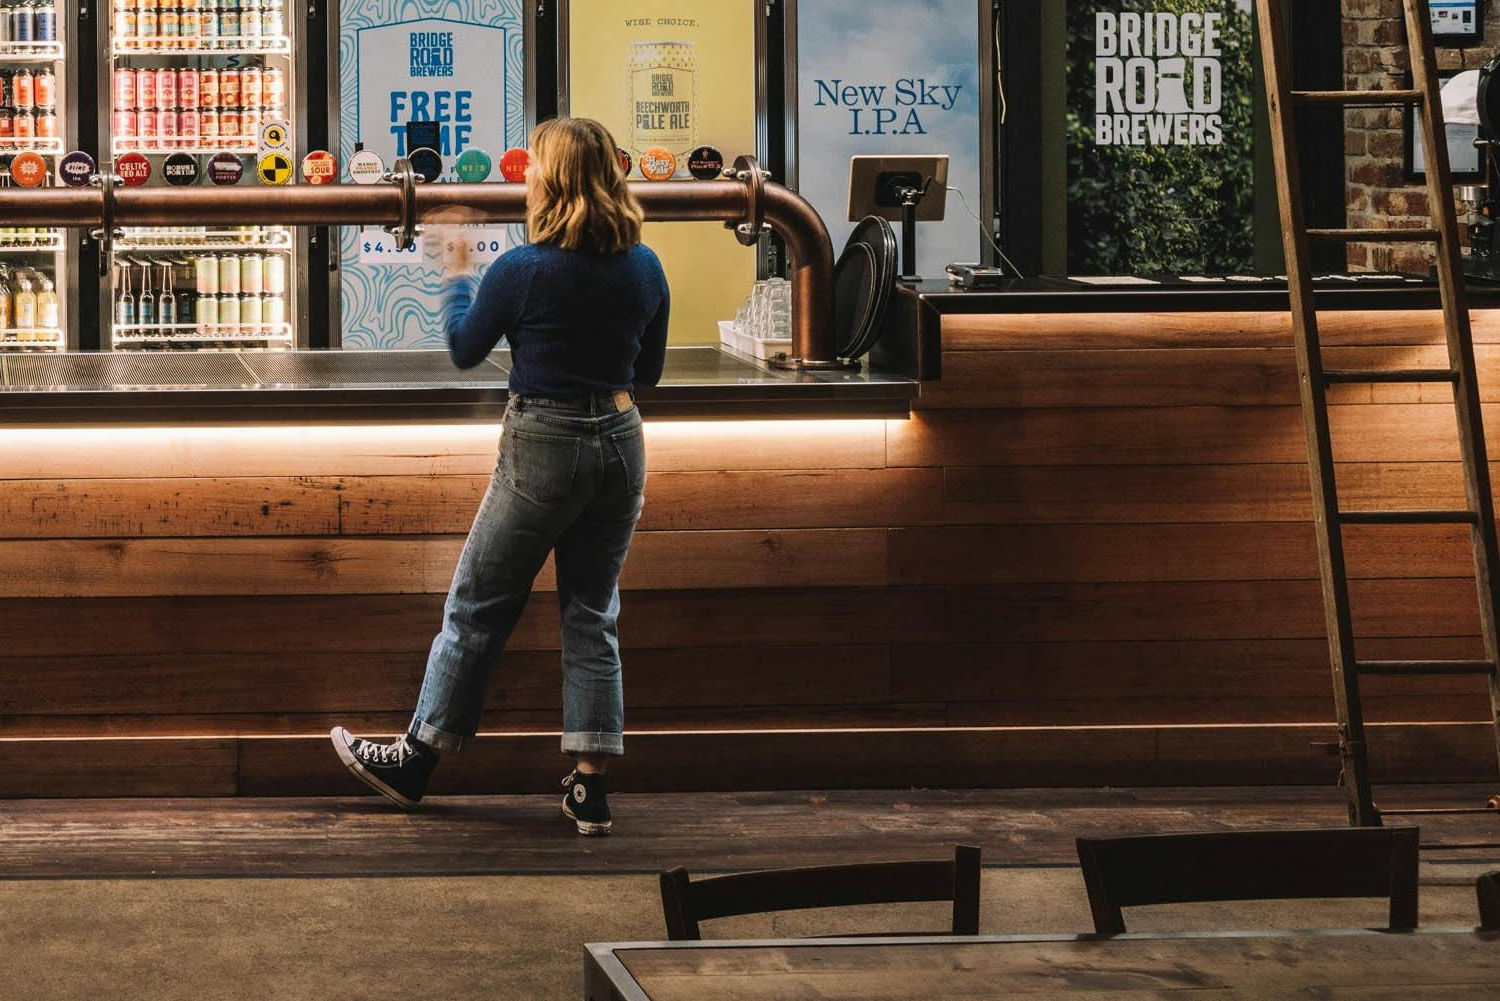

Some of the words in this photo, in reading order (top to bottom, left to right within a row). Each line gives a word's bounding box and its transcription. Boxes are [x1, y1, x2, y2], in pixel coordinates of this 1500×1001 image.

[625, 19, 651, 27] WISE
[658, 19, 700, 27] CHOICE.
[410, 33, 452, 48] BRIDGE
[1095, 12, 1222, 57] BRIDGE
[411, 67, 453, 77] BREWERS
[814, 79, 888, 107] New
[895, 79, 963, 109] Sky
[390, 91, 472, 122] FREE
[636, 101, 689, 113] BEECHWORTH
[1095, 114, 1222, 145] BREWERS
[311, 166, 329, 174] SOUR
